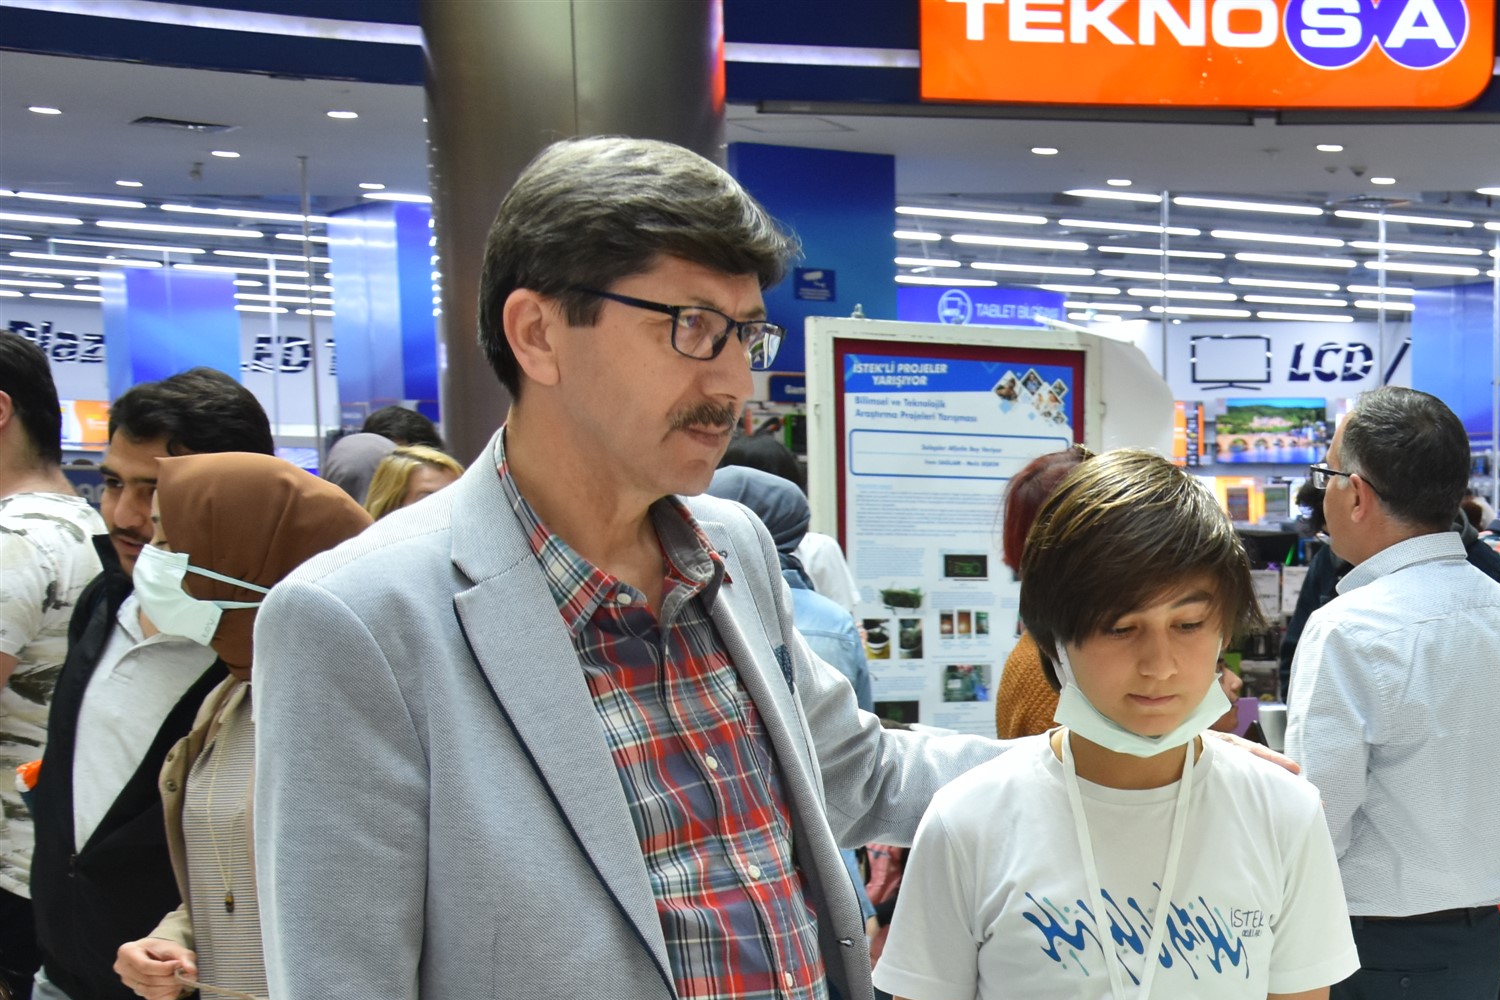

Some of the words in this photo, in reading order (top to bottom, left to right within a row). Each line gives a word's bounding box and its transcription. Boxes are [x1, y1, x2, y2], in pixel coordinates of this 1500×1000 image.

[947, 0, 1456, 49] TEKNOSA
[898, 363, 948, 373] PROJELER
[1288, 342, 1374, 382] LCD
[872, 376, 927, 387] YARIŞIYOR
[855, 397, 888, 405] Bilimsel
[904, 399, 945, 409] Teknolojik
[855, 409, 897, 419] Araştırma
[900, 411, 935, 421] Projeleri
[938, 413, 977, 422] Yarışması
